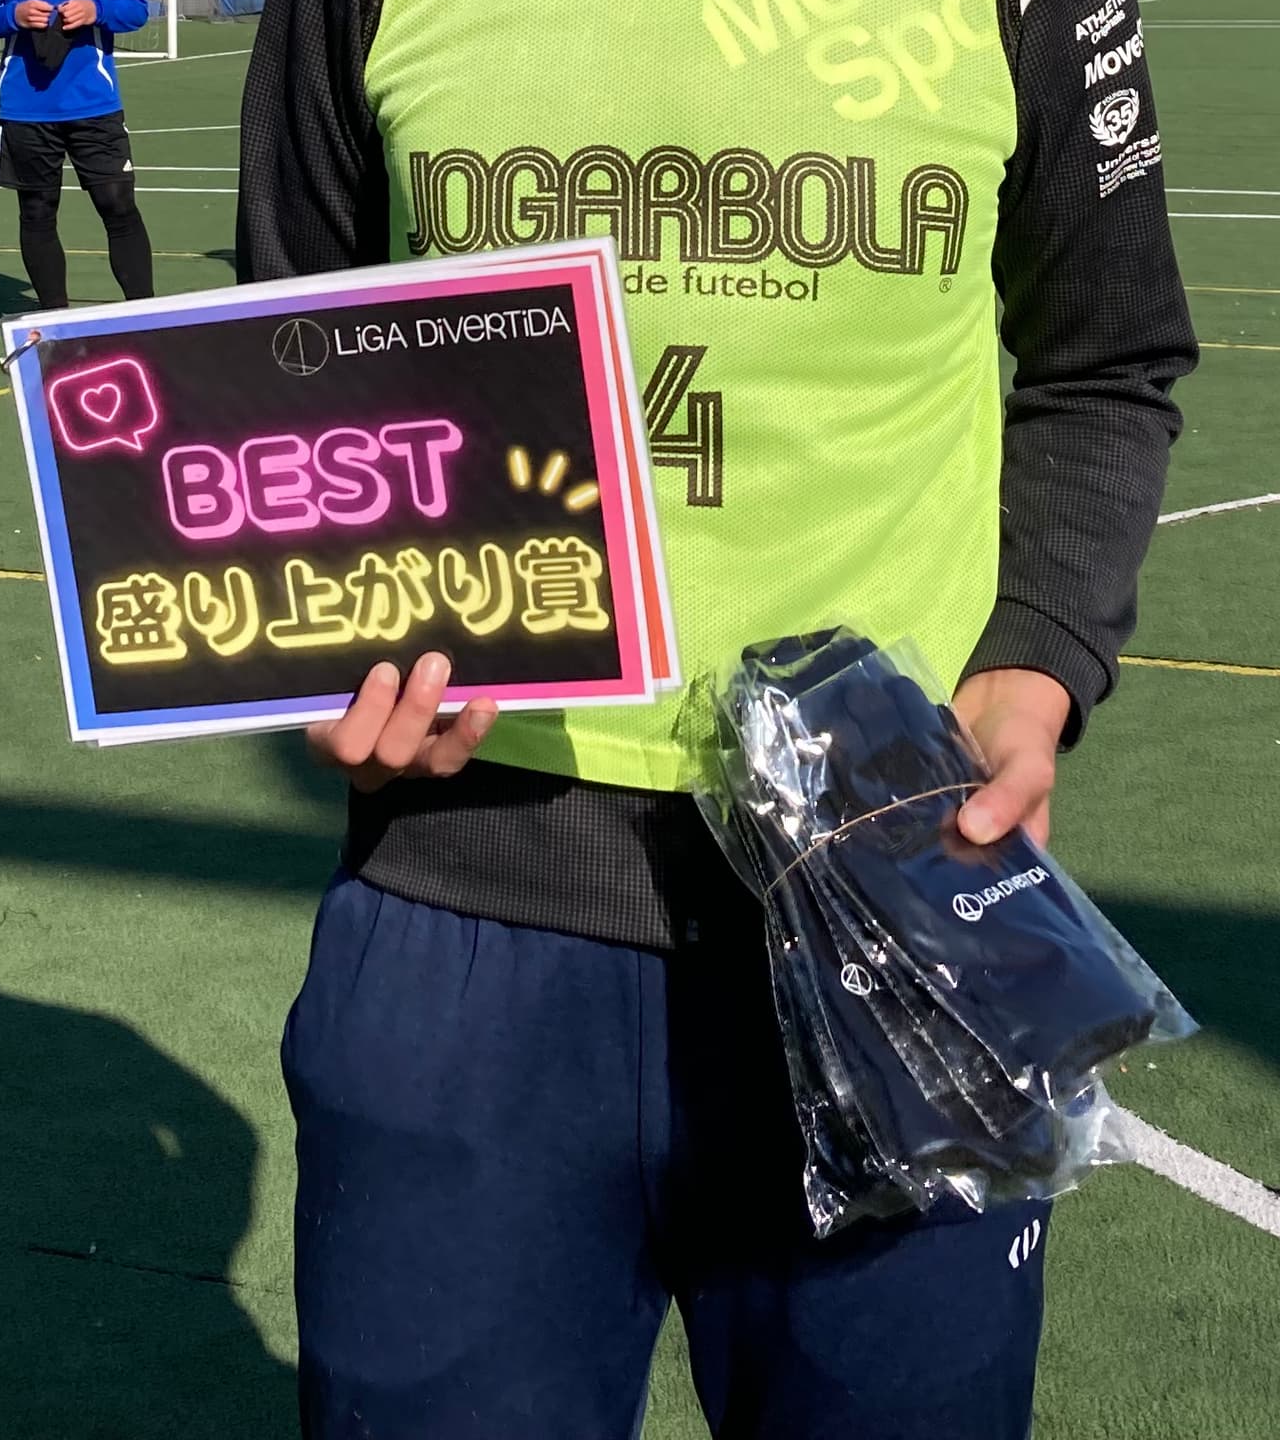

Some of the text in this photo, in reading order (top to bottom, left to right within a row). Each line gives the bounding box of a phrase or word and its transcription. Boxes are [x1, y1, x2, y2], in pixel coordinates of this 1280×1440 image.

[1091, 9, 1126, 45] Originals
[1106, 103, 1132, 133] 35
[407, 144, 970, 275] JOGARBOLA
[624, 265, 820, 302] de futebol
[162, 418, 462, 541] BEST
[638, 344, 724, 508] 4
[96, 536, 609, 665] 盛り上がり賞
